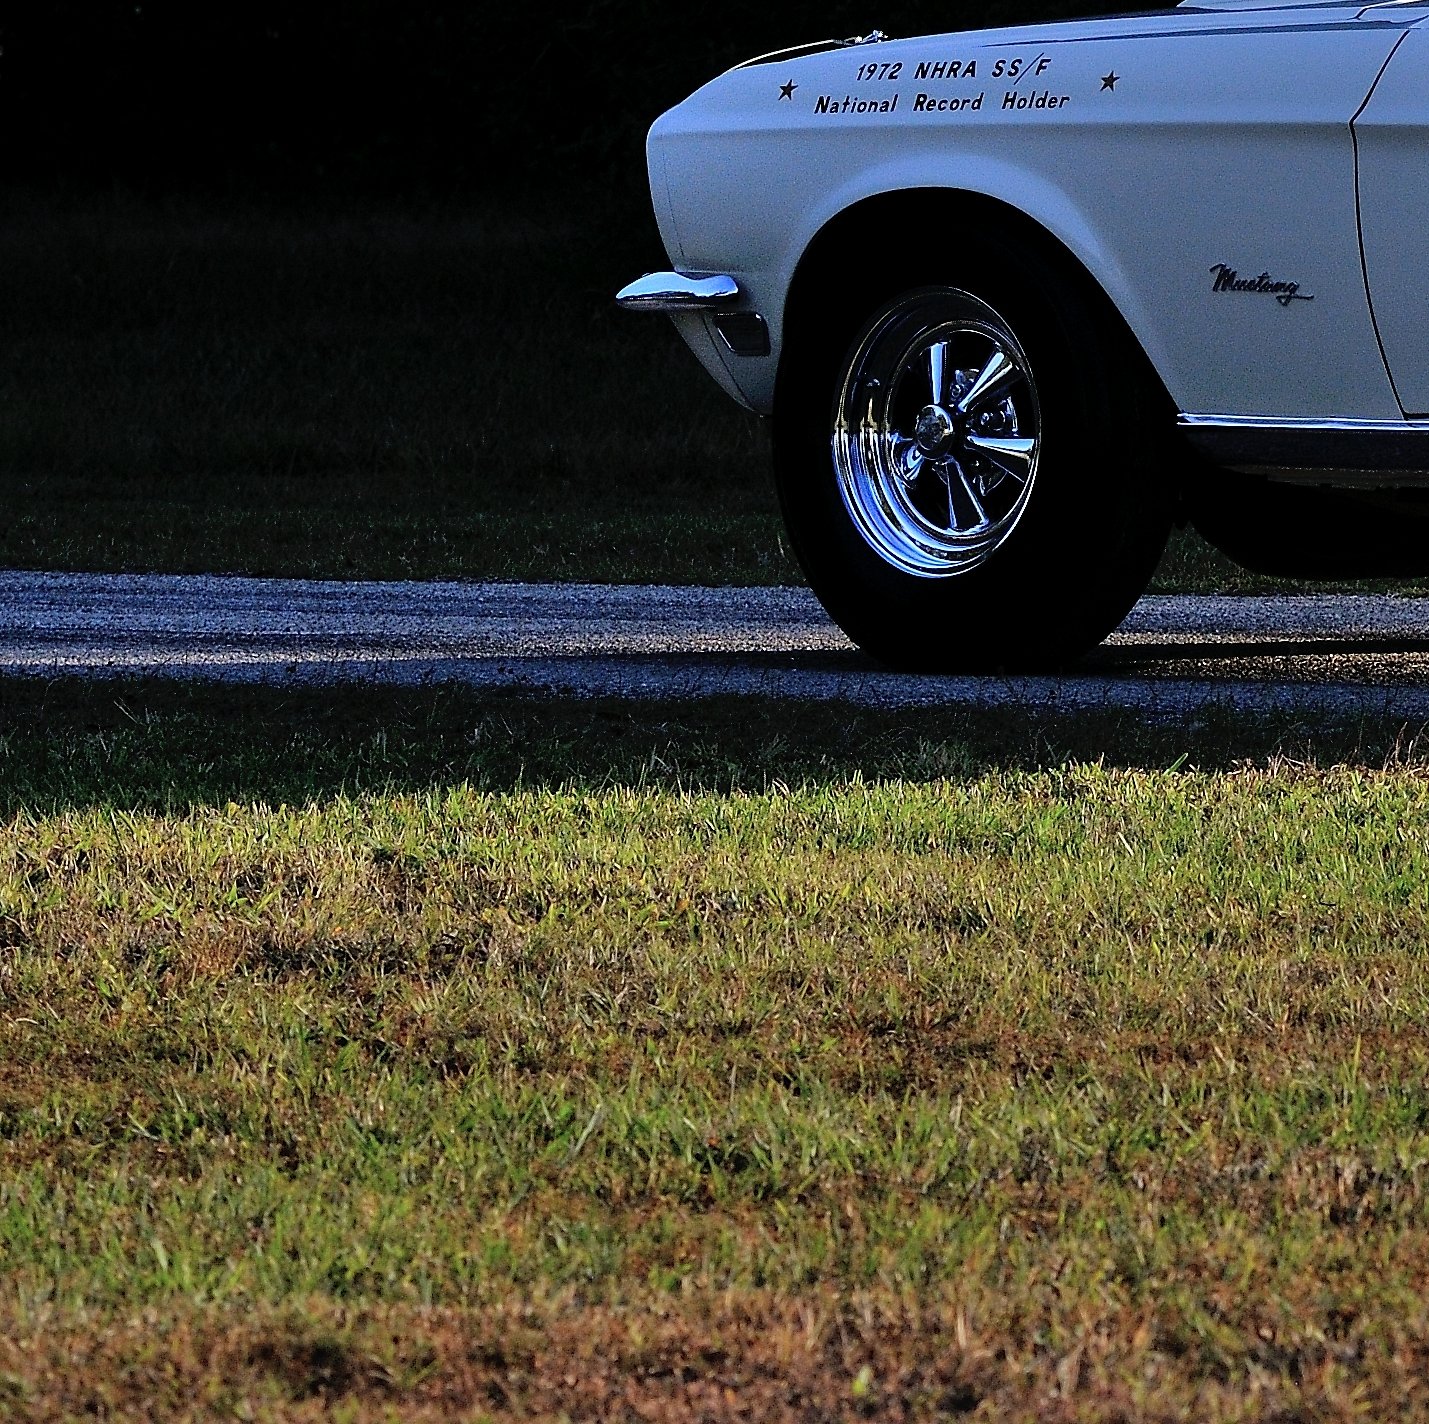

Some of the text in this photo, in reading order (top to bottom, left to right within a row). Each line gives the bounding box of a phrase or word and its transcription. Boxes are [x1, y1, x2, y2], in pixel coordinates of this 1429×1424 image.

[857, 53, 1051, 84] 1972 NHRA SS/F
[814, 91, 1070, 114] National Record Holder
[1209, 263, 1314, 306] Mustang
